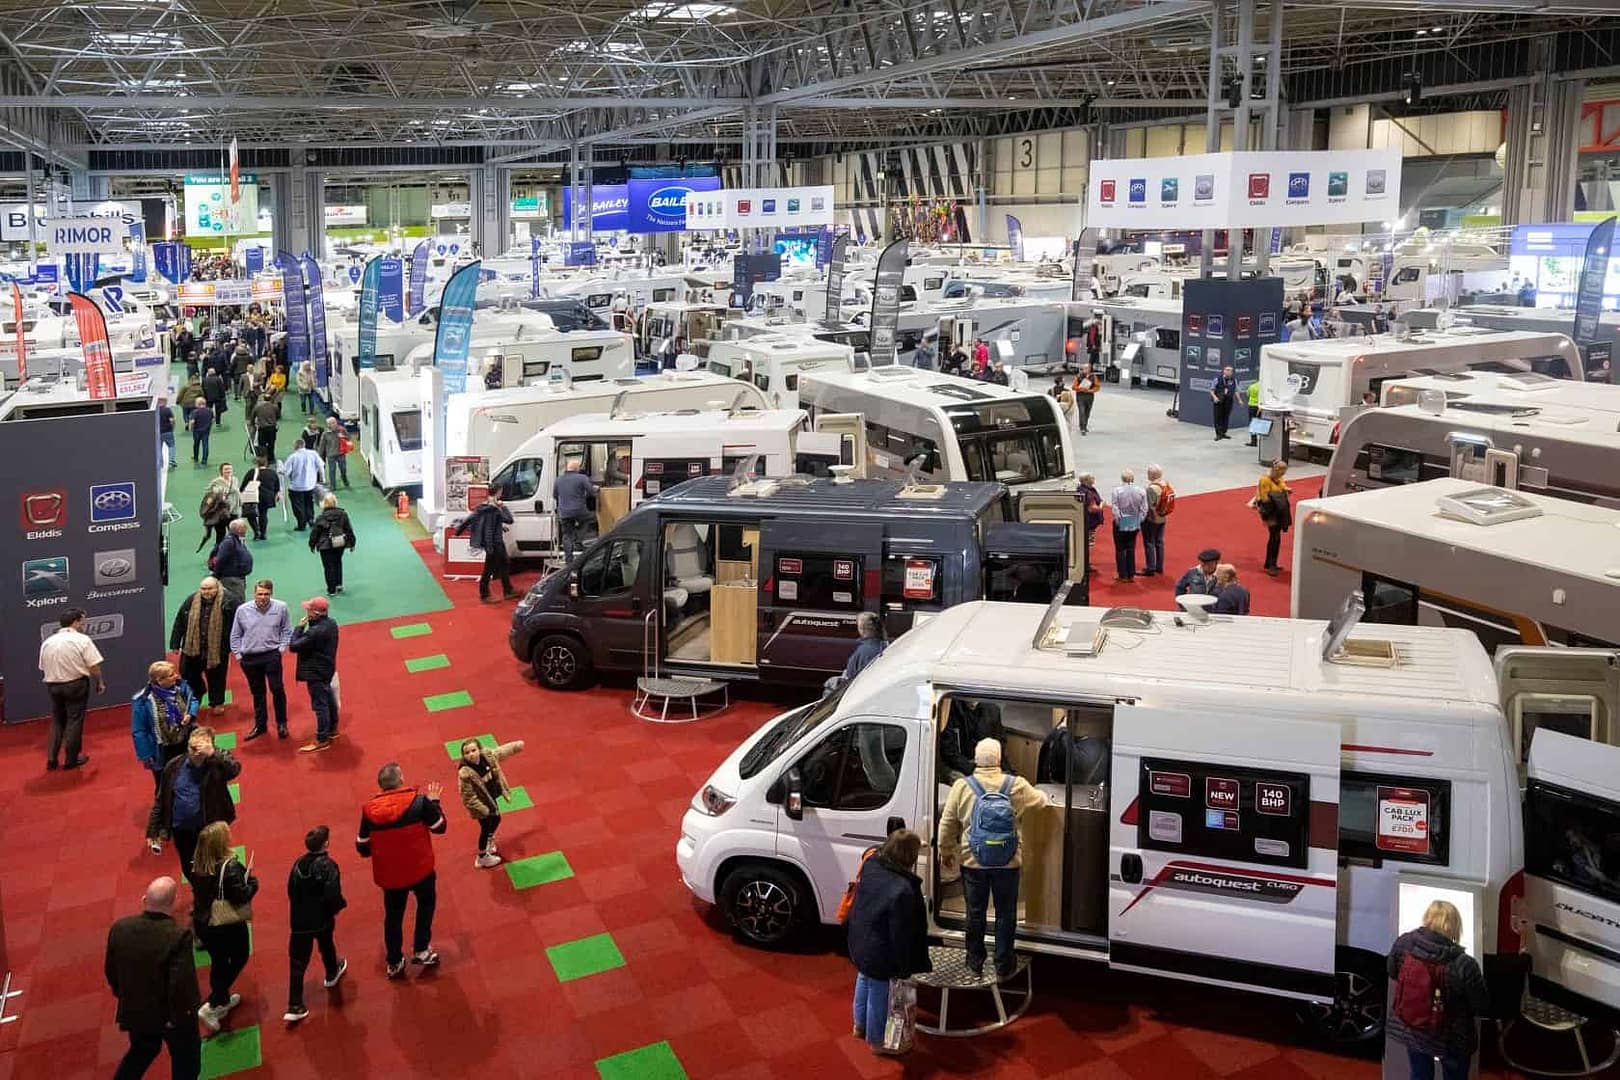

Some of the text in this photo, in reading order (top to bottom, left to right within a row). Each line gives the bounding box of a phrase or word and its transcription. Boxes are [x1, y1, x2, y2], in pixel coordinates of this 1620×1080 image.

[1021, 139, 1032, 168] 3
[651, 196, 687, 208] BAILE
[55, 227, 112, 243] RIMOR
[88, 521, 140, 533] Compass
[26, 530, 63, 540] Elddis
[86, 587, 145, 600] Buccaneer
[26, 596, 68, 608] Xplore
[792, 619, 839, 628] autoquest
[1210, 791, 1235, 801] NEW
[1262, 789, 1283, 799] 140
[1261, 798, 1285, 808] BHP
[1384, 807, 1403, 815] CAB
[1391, 814, 1414, 822] PACK
[1174, 872, 1262, 891] autoquest
[1555, 902, 1620, 929] DUCAT
